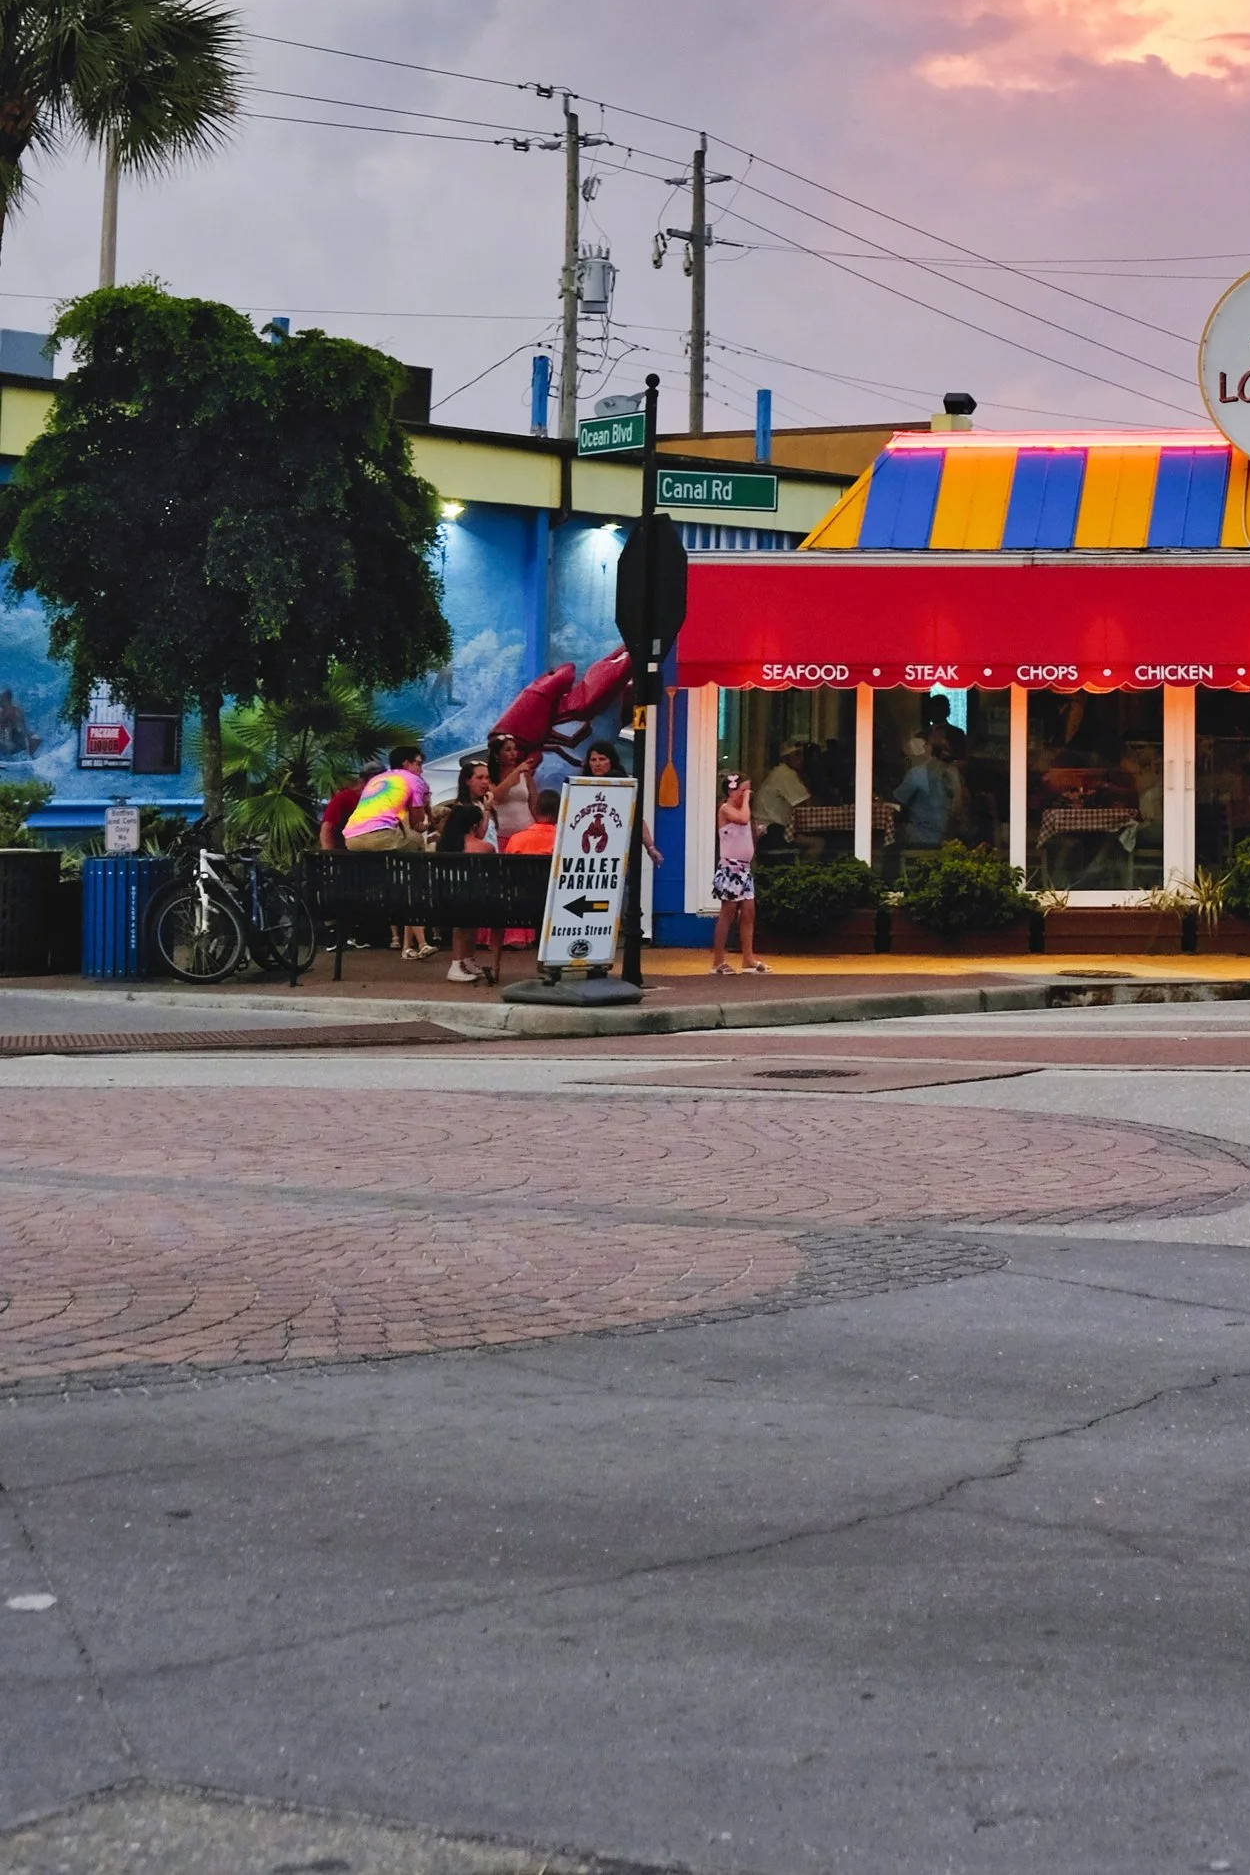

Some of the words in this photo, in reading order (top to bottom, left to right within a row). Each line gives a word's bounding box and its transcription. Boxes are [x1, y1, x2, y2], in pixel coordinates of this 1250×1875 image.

[581, 428, 610, 448] Ocean
[612, 422, 633, 444] Blvd
[662, 478, 707, 500] Canal
[711, 480, 733, 501] Rd
[762, 664, 849, 680] SEAFOOD
[905, 665, 959, 680] STEAK
[1016, 665, 1078, 680] CHOPS
[1134, 665, 1213, 680] CHICKEN
[570, 803, 608, 830] LOBSTER
[609, 808, 623, 829] POT
[562, 858, 620, 873] VALET
[558, 874, 618, 890] PARKING
[551, 926, 582, 936] Across
[585, 925, 612, 936] Street
